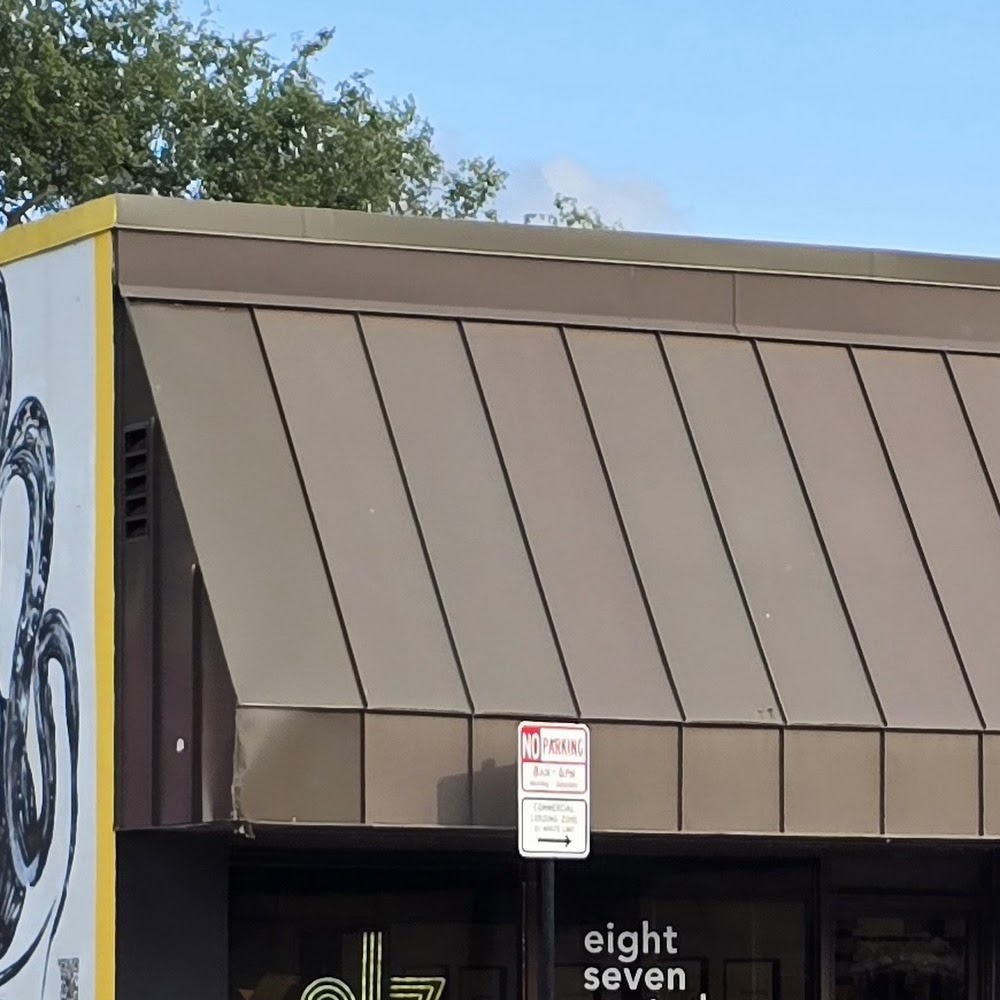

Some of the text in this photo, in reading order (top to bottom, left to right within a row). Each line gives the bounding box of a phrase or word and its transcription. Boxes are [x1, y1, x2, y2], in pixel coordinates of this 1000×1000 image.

[522, 732, 584, 761] NO PARKING
[584, 920, 678, 963] eight
[583, 967, 686, 991] seven
